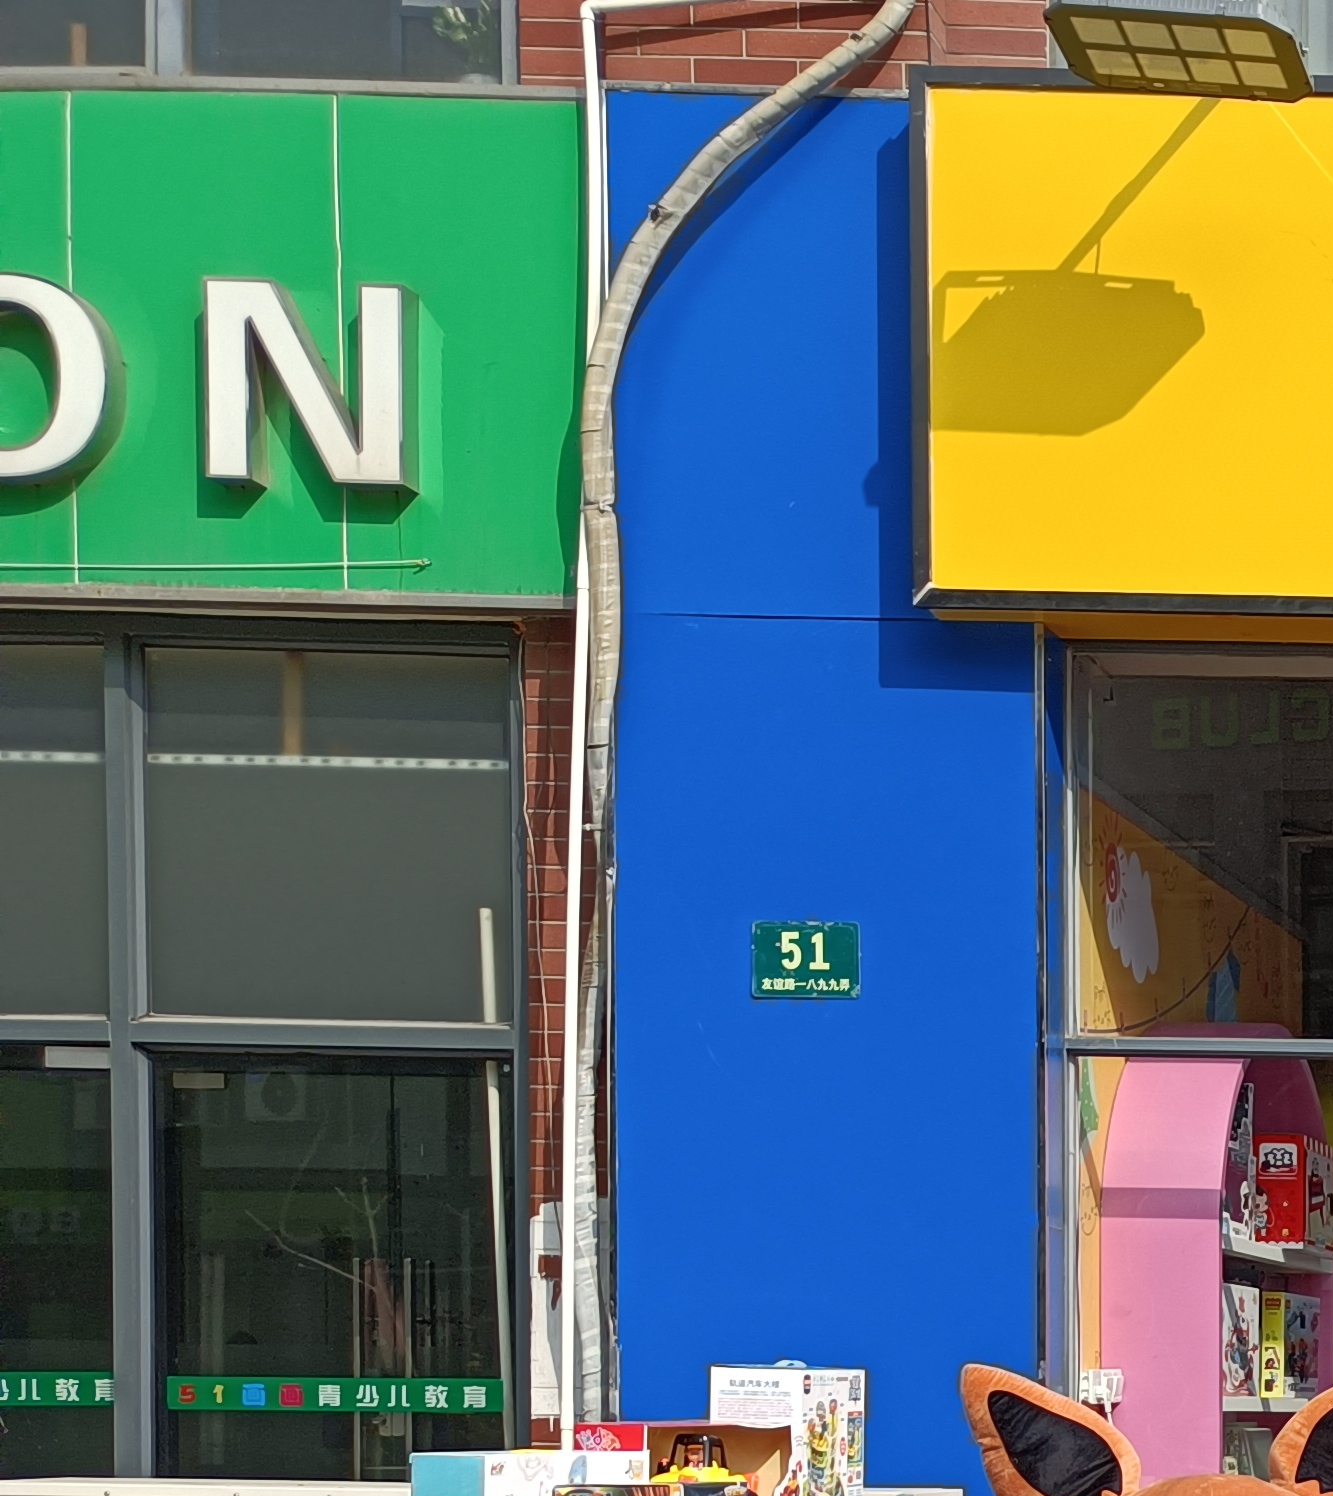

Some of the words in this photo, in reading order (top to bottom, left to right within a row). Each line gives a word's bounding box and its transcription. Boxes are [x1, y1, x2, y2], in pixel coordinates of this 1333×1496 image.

[0, 272, 412, 490] ON
[780, 931, 831, 970] 51
[761, 978, 851, 991] 友谊路一八九九弄
